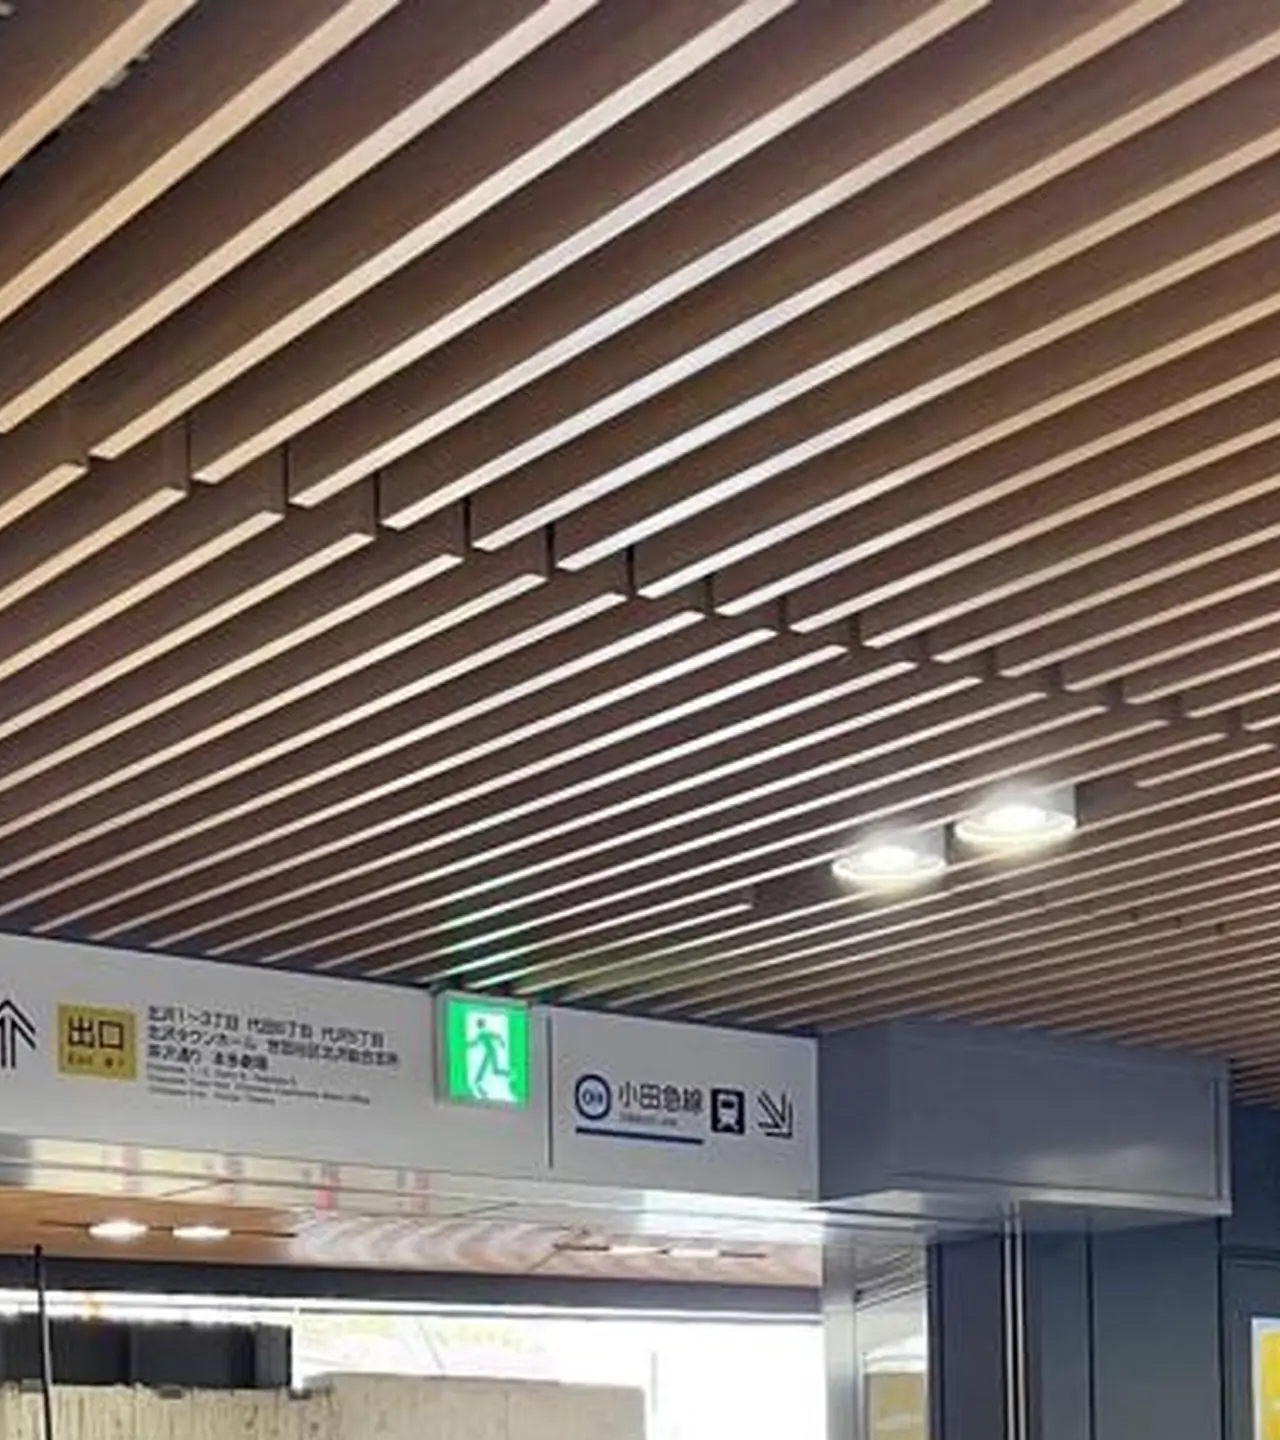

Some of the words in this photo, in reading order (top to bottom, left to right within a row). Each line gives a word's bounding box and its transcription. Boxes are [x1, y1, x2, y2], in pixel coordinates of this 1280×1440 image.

[68, 1016, 124, 1051] 出口
[618, 1080, 703, 1116] 小田急線
